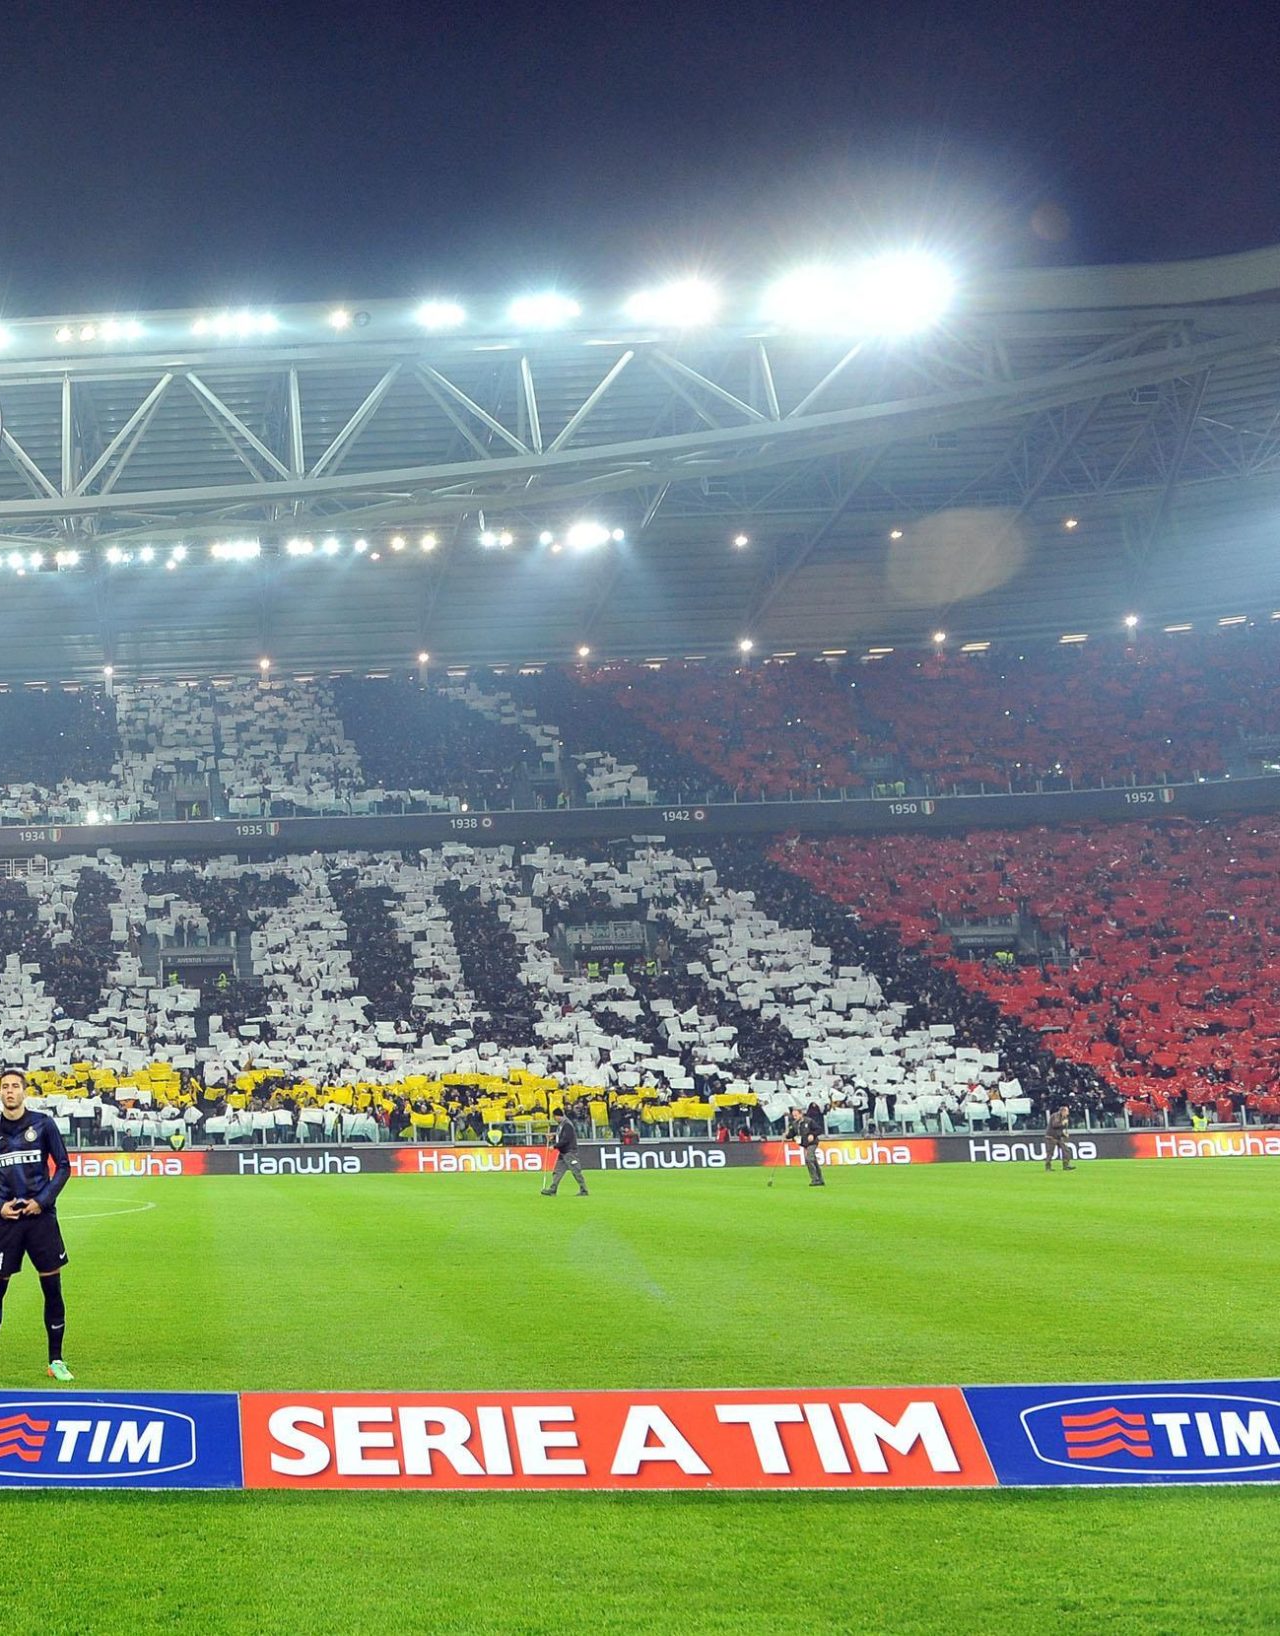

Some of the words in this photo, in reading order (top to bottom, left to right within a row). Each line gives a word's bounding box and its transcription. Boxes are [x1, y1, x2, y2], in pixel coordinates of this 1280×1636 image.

[888, 803, 917, 815] 1950
[1124, 792, 1155, 804] 1952
[450, 818, 477, 829] 1938
[662, 810, 690, 822] 1942
[19, 831, 45, 842] 1934
[235, 825, 263, 836] 1935
[1155, 1133, 1280, 1157] Hanwha
[70, 1154, 182, 1176] Hanwha
[238, 1151, 361, 1175] Hanwha
[417, 1148, 542, 1173] Hanwha
[600, 1146, 726, 1169] Hanwha
[55, 1419, 166, 1463] TIM
[268, 1405, 587, 1476] SERIE
[610, 1404, 711, 1475] A
[715, 1401, 962, 1474] TIM
[1151, 1411, 1280, 1457] TIM
